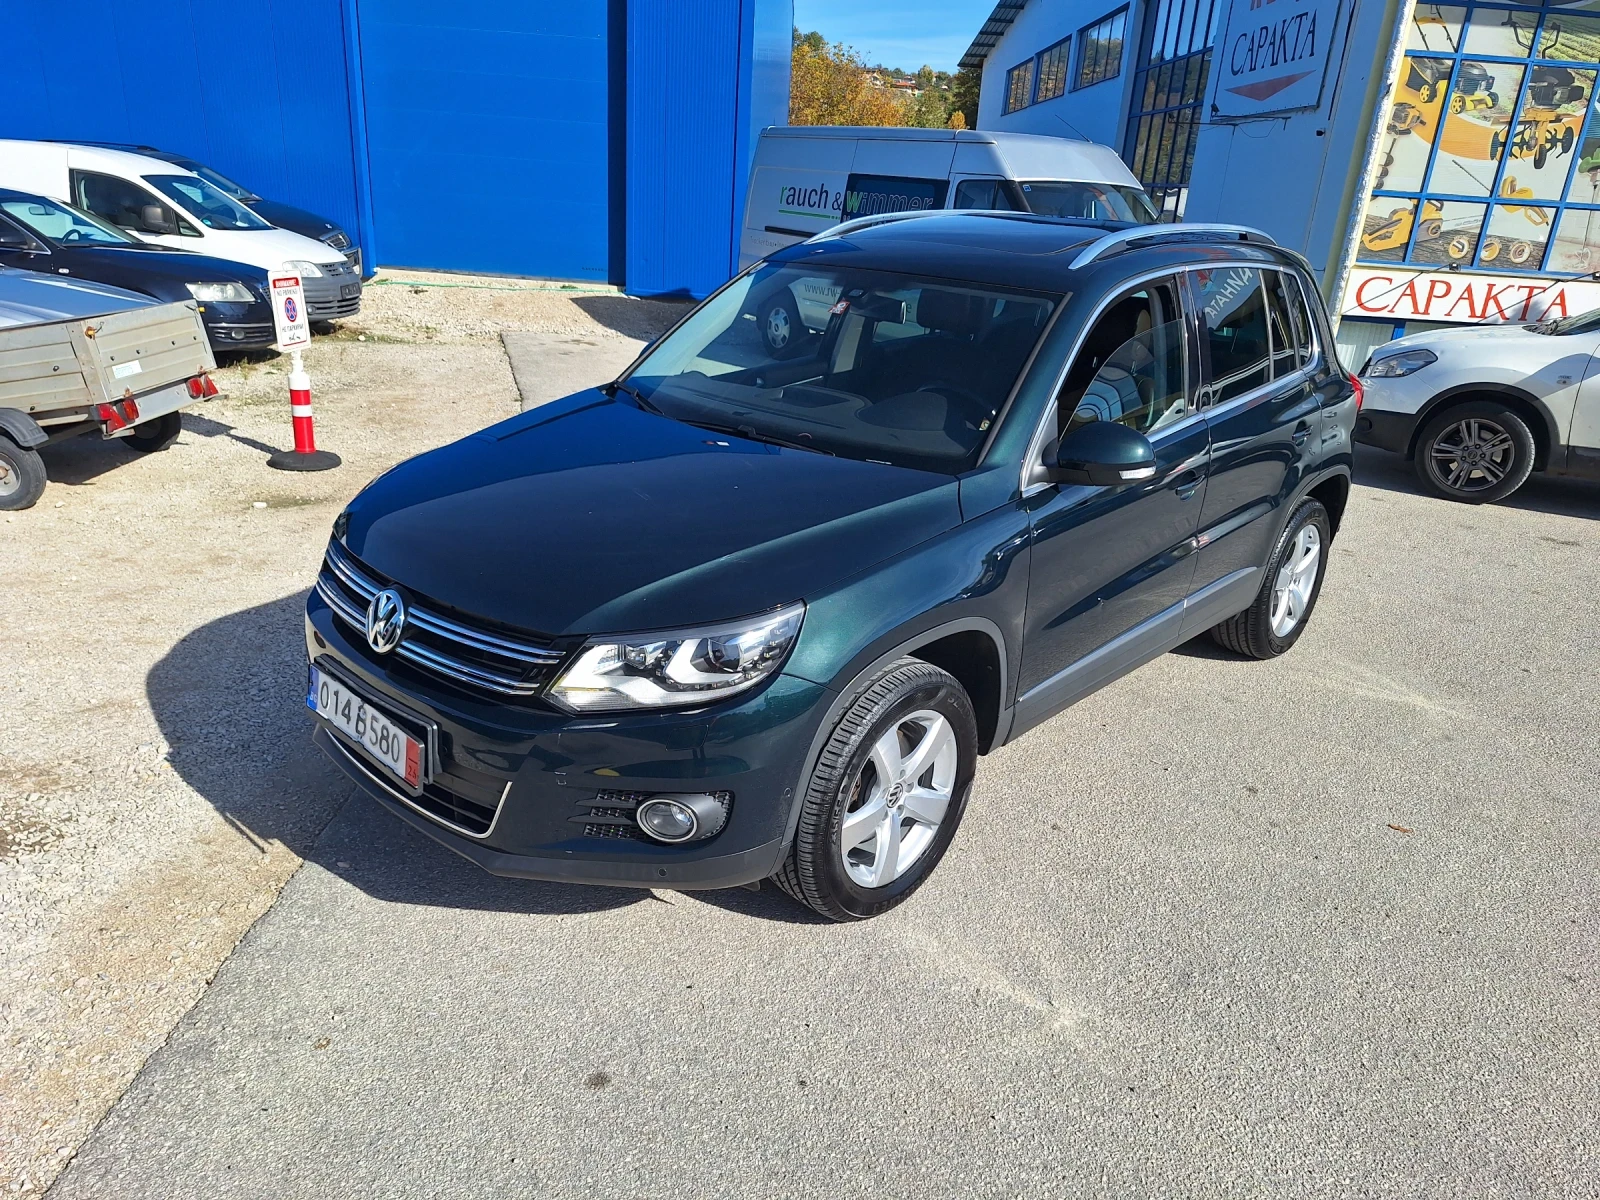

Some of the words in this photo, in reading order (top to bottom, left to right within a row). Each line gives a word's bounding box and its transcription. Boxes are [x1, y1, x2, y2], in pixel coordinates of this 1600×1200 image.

[779, 183, 829, 210] rauch
[831, 192, 842, 211] &
[846, 190, 934, 216] wimmer
[1355, 276, 1569, 323] САРАКТА
